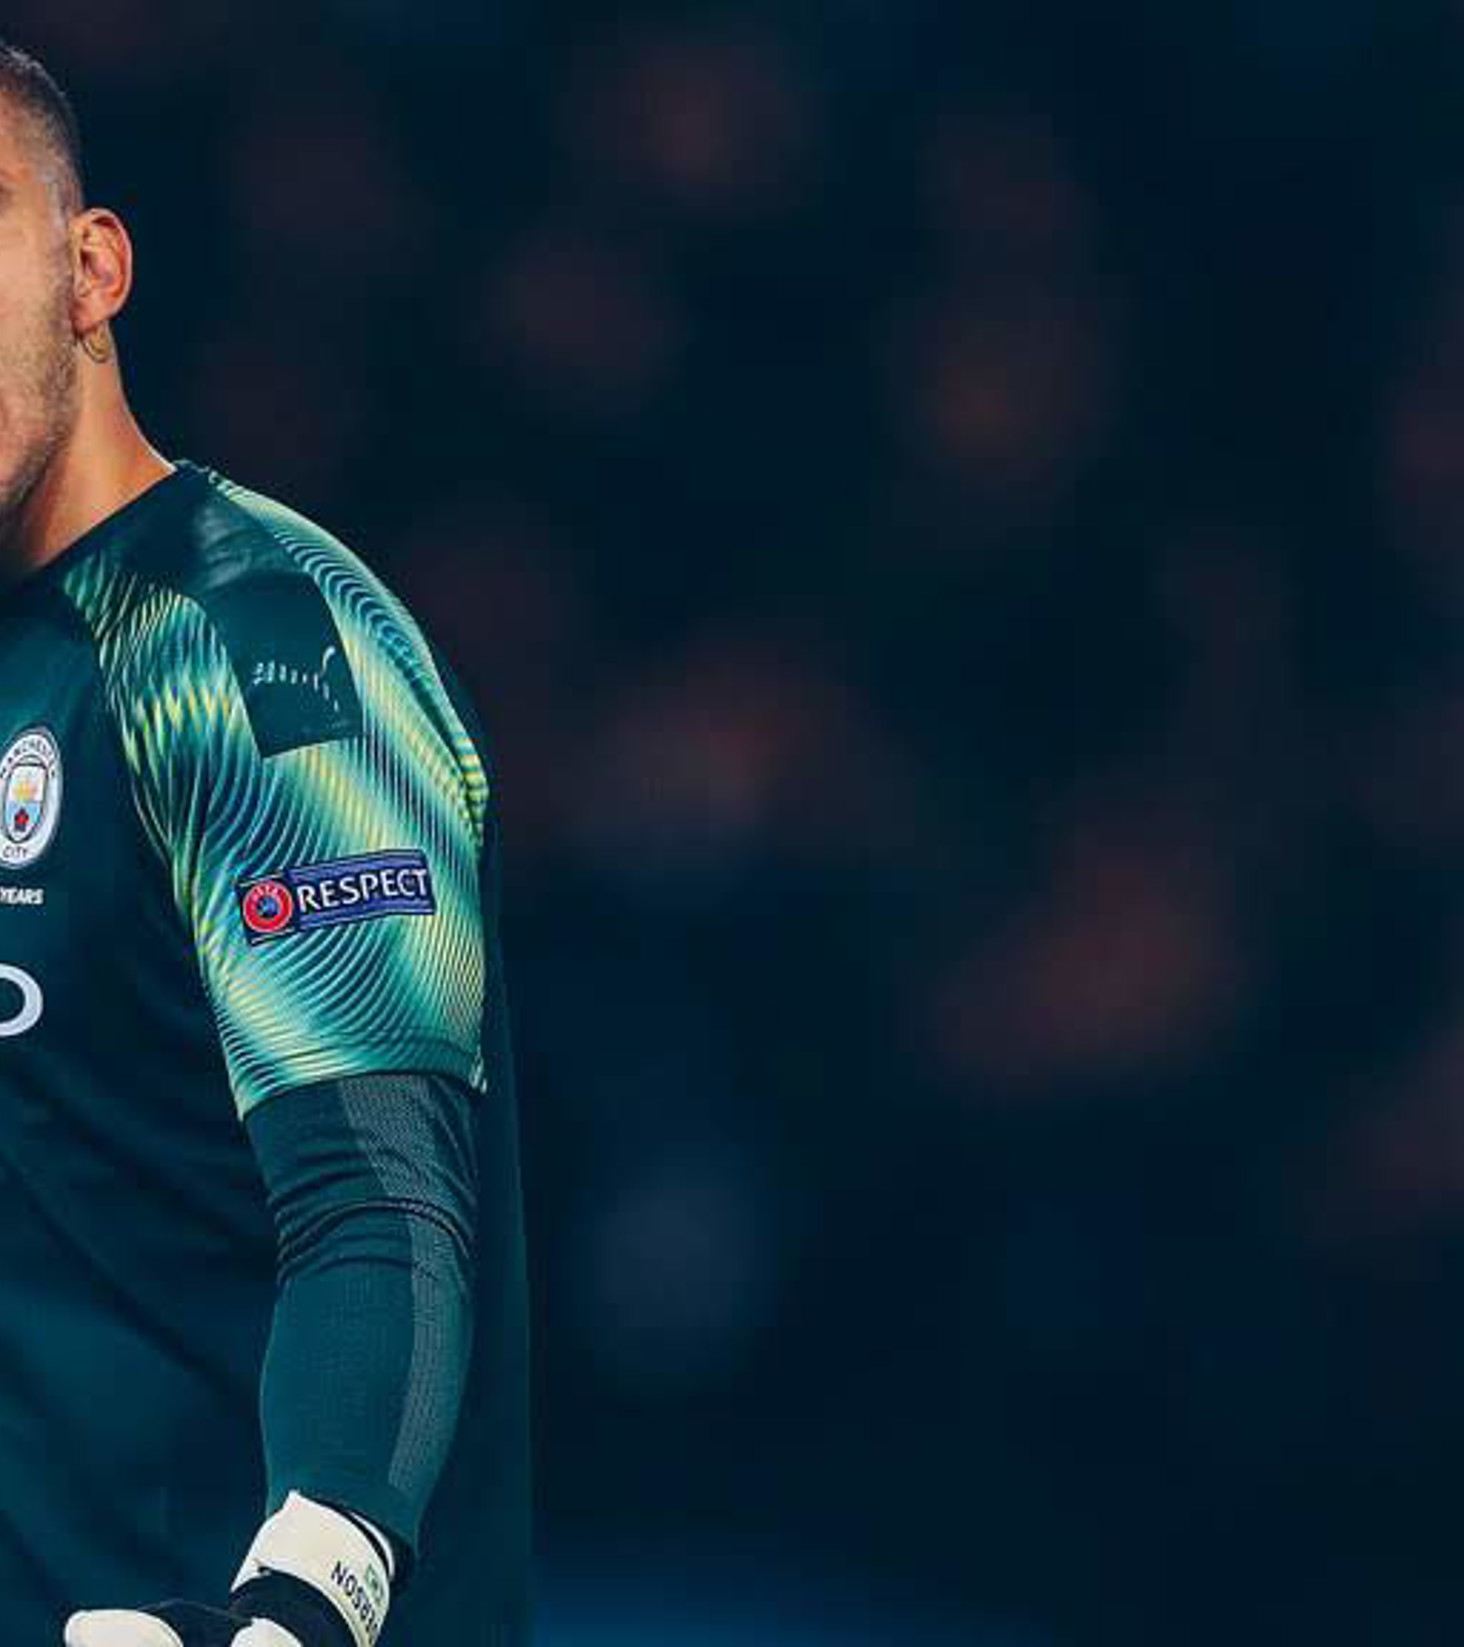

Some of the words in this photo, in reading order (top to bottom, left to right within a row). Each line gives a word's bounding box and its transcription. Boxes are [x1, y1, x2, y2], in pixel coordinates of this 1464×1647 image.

[2, 845, 28, 859] CITY
[0, 885, 45, 905] YEARS
[296, 868, 428, 913] RESPECT
